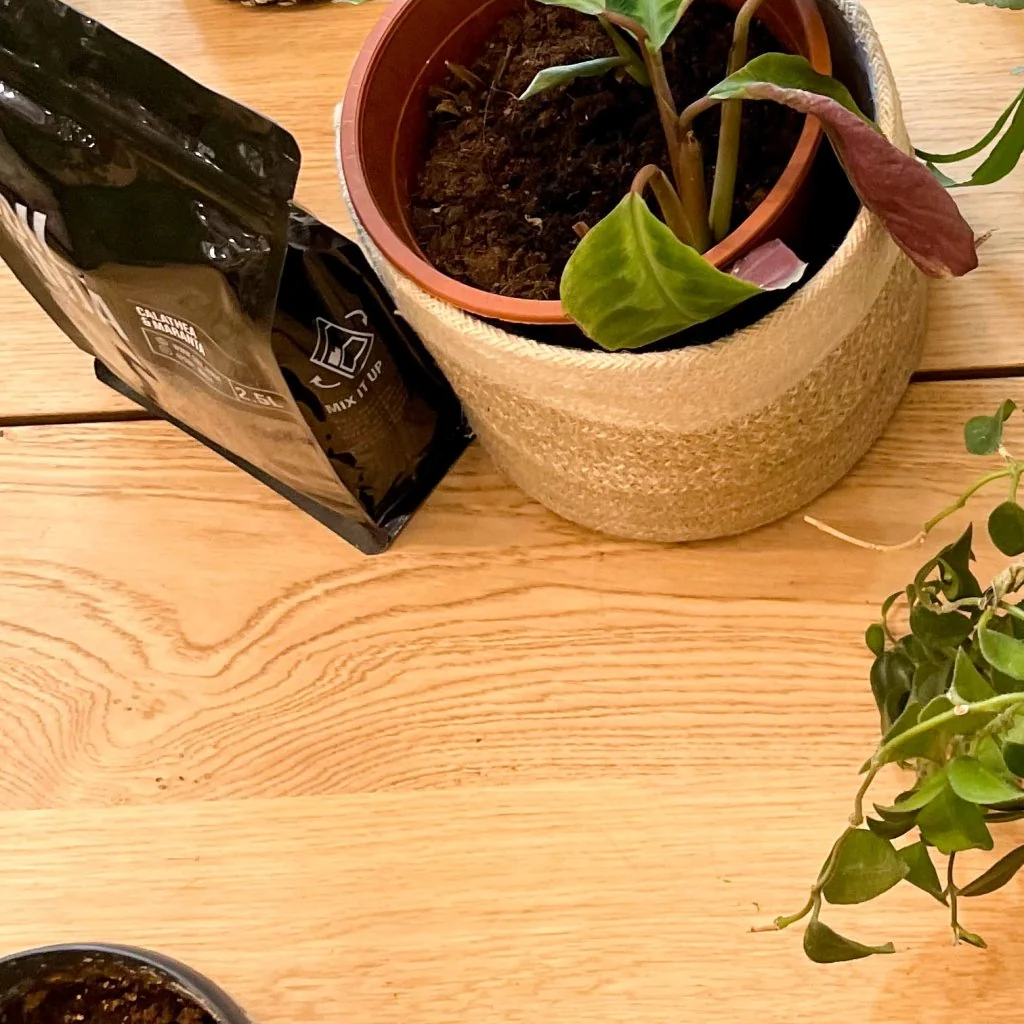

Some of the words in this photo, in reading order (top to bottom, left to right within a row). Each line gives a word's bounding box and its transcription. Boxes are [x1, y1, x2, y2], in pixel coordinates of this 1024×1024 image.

[135, 306, 198, 339] CALATHEA
[154, 321, 206, 357] MARANTA
[234, 386, 285, 409] 2.5L
[325, 395, 357, 414] MIX
[356, 380, 369, 398] IT
[366, 360, 383, 383] UP
